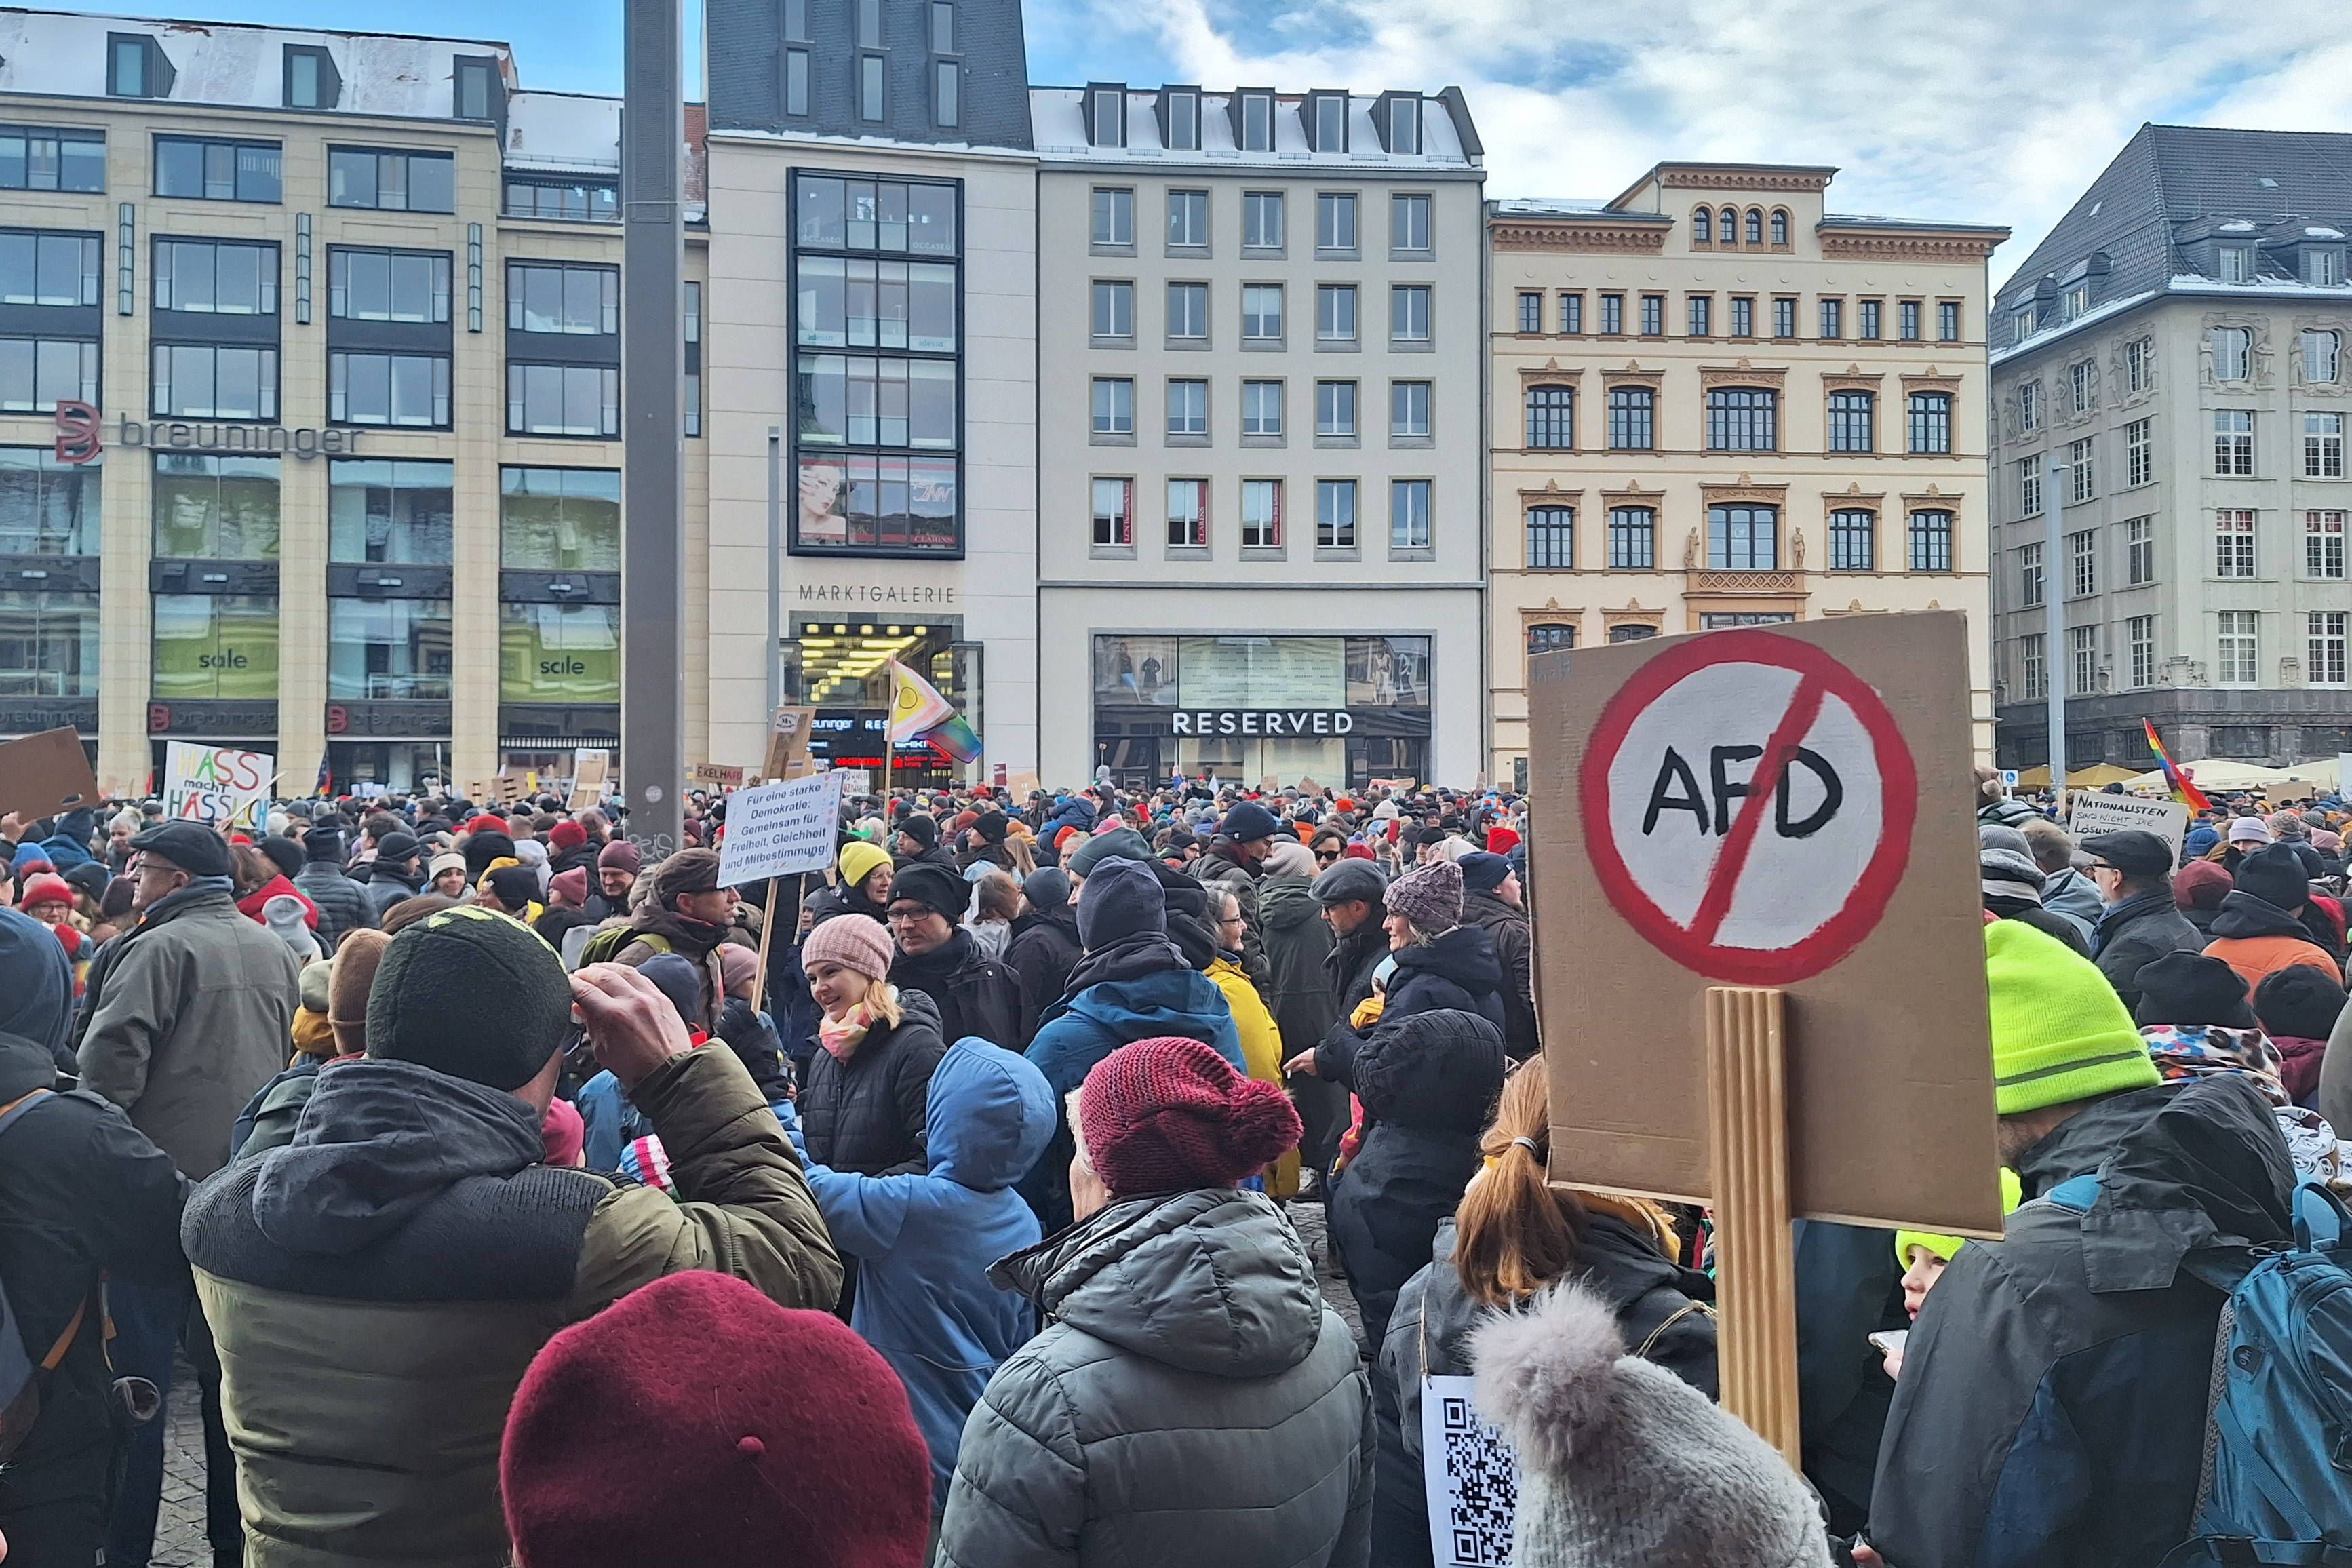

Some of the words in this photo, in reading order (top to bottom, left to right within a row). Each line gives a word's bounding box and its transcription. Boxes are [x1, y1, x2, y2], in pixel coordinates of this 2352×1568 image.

[121, 412, 364, 460] breuninger
[800, 585, 954, 603] MARKTGALERIE
[199, 648, 248, 668] sale
[540, 656, 585, 674] sale
[811, 719, 853, 730] euninger
[1173, 712, 1353, 734] RESERVED
[178, 745, 260, 791] HASS
[747, 796, 764, 806] Für
[766, 791, 786, 802] eine
[789, 783, 821, 795] starke
[1642, 745, 1843, 839] AFD
[751, 800, 811, 819] Demokratie:
[2077, 795, 2168, 817] NATIONALISTEN
[741, 817, 800, 836] Gemeinsam
[803, 813, 818, 823] für
[2075, 812, 2098, 820] SIND
[2100, 815, 2131, 823] NICHT
[2135, 817, 2154, 827] DIE
[731, 838, 769, 854] Freiheit,
[772, 827, 826, 845] Gleichheit
[725, 857, 743, 870] und
[746, 842, 829, 865] Mitbestimmung!
